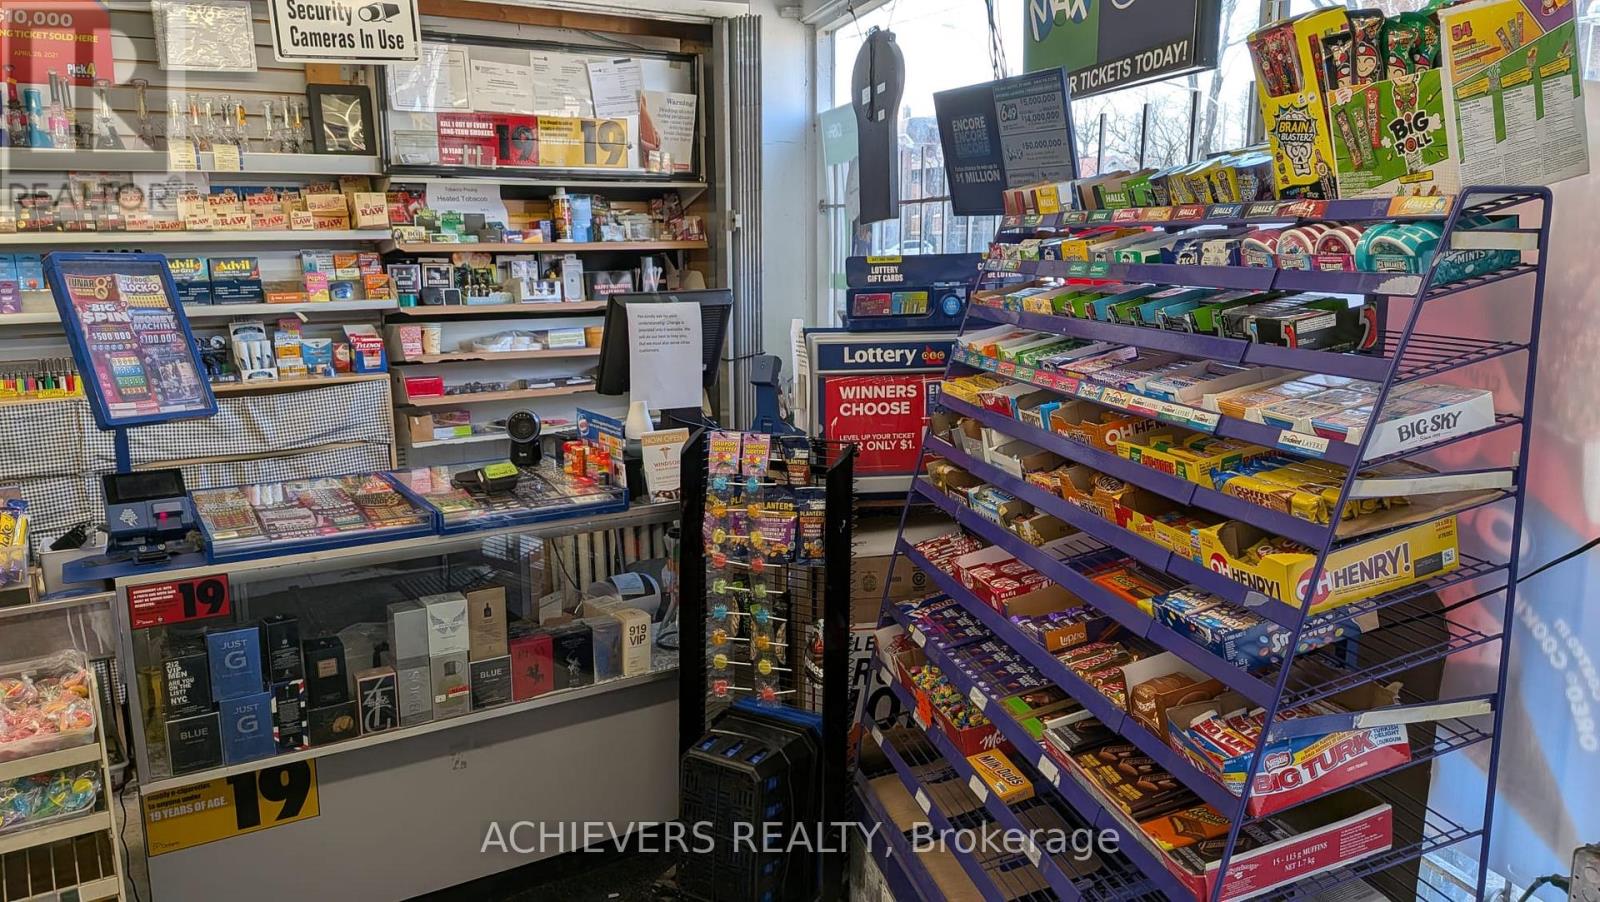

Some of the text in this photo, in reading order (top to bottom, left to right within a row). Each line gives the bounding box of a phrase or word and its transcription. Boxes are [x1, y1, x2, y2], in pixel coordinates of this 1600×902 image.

[287, 0, 352, 26] Security
[16, 30, 99, 43] TICKET SOLD HERE
[290, 25, 405, 49] Cameras In Use
[1452, 21, 1473, 41] 54
[1080, 40, 1188, 91] TICKETS TODAY!
[952, 116, 987, 131] ENCORE
[1279, 121, 1310, 133] BRAIN
[496, 125, 534, 161] 19
[581, 120, 626, 165] 19
[1281, 133, 1313, 142] BLASTERZ
[966, 168, 1000, 183] MILLION
[309, 183, 331, 194] RAW
[208, 195, 237, 206] RAW
[247, 194, 275, 205] RAW
[1105, 193, 1126, 203] HALLS
[1403, 196, 1435, 210] HALLS
[361, 206, 385, 216] RAW
[1179, 208, 1197, 217] HALLS
[1213, 206, 1234, 216] HALLS
[1252, 203, 1275, 215] HALLS
[1289, 202, 1316, 216] HALLS
[221, 216, 247, 226] RAW
[259, 216, 285, 226] RAW
[317, 219, 343, 229] RAW
[1456, 249, 1486, 261] MINTS
[218, 259, 250, 270] Advil
[871, 266, 898, 275] LOTTERY
[883, 274, 904, 282] CARDS
[91, 303, 116, 312] BIG
[133, 322, 177, 331] MACHINE
[843, 347, 917, 365] Lottery
[839, 384, 918, 399] WINNERS
[1105, 391, 1127, 405] Trident
[839, 402, 910, 416] CHOOSE
[1398, 411, 1462, 442] BIG SKY
[840, 434, 860, 442] LEVEL
[872, 433, 888, 441] YOUR
[890, 432, 915, 441] TICKET
[1106, 422, 1133, 446] OH
[866, 440, 916, 451] ONLY $1.
[1282, 435, 1324, 449] Trident LAYERS
[1211, 558, 1233, 580] OH
[1334, 542, 1410, 589] HENRY!
[178, 579, 226, 618] 19
[629, 624, 647, 636] 919
[220, 639, 249, 650] JUST
[629, 635, 647, 646] VIP
[166, 661, 180, 669] 212
[224, 651, 247, 669] G
[167, 666, 182, 675] VIP
[168, 671, 188, 680] MEN
[480, 669, 502, 679] BLUE
[171, 696, 188, 705] NYC
[234, 704, 259, 715] JUST
[237, 715, 258, 733] G
[1373, 725, 1399, 733] TURKISH
[180, 727, 209, 740] BLUE
[1374, 730, 1400, 739] DELIGHT
[1302, 731, 1379, 779] TURK
[979, 755, 1024, 786] Milk Duds
[1253, 768, 1303, 793] BIG
[226, 760, 312, 830] 19
[150, 796, 228, 822] 19 YEARS OF AGE.
[1272, 858, 1280, 866] 15
[1302, 841, 1328, 856] MUFFINS
[1284, 863, 1296, 872] NET
[1308, 857, 1316, 866] kg
